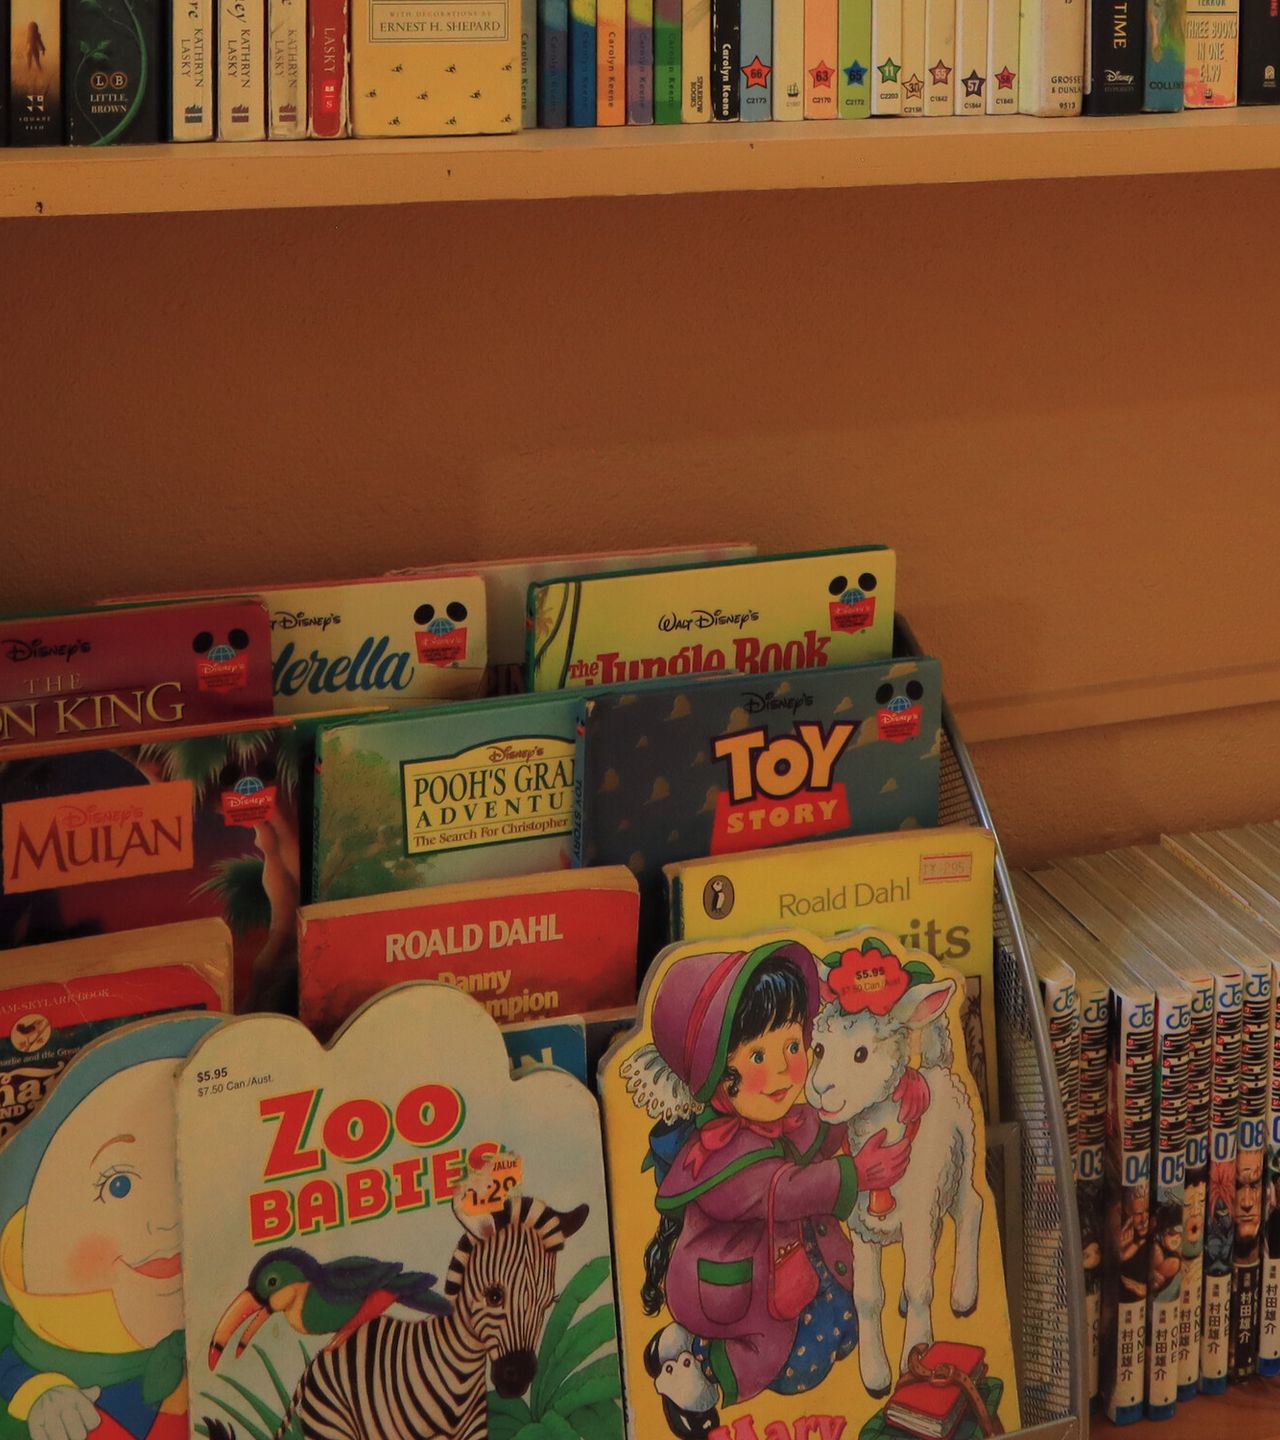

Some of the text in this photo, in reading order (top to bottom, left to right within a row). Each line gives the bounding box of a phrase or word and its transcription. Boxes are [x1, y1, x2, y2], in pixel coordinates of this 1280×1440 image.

[446, 20, 501, 33] SHEPARD
[1113, 2, 1128, 49] TIME
[323, 26, 337, 74] LASKY
[23, 673, 83, 696] THE
[54, 681, 187, 734] KING
[712, 719, 860, 805] TOY
[414, 767, 507, 808] POOH'S
[413, 818, 569, 847] The Search For Christopher
[726, 800, 840, 836] STORY
[10, 813, 184, 879] MULAN
[779, 877, 911, 919] Roald Dahl
[385, 913, 565, 963] ROALD DAHL
[196, 1066, 229, 1083] $5.95
[197, 1081, 225, 1097] $7.50
[258, 1083, 467, 1185] ZOO
[1215, 1131, 1238, 1159] 07
[1239, 1120, 1264, 1148] 08
[1080, 1148, 1104, 1178] 03
[1160, 1154, 1184, 1183] 05
[1186, 1137, 1207, 1167] 06
[1125, 1154, 1150, 1184] 04
[1119, 1328, 1134, 1381] 村田雄介
